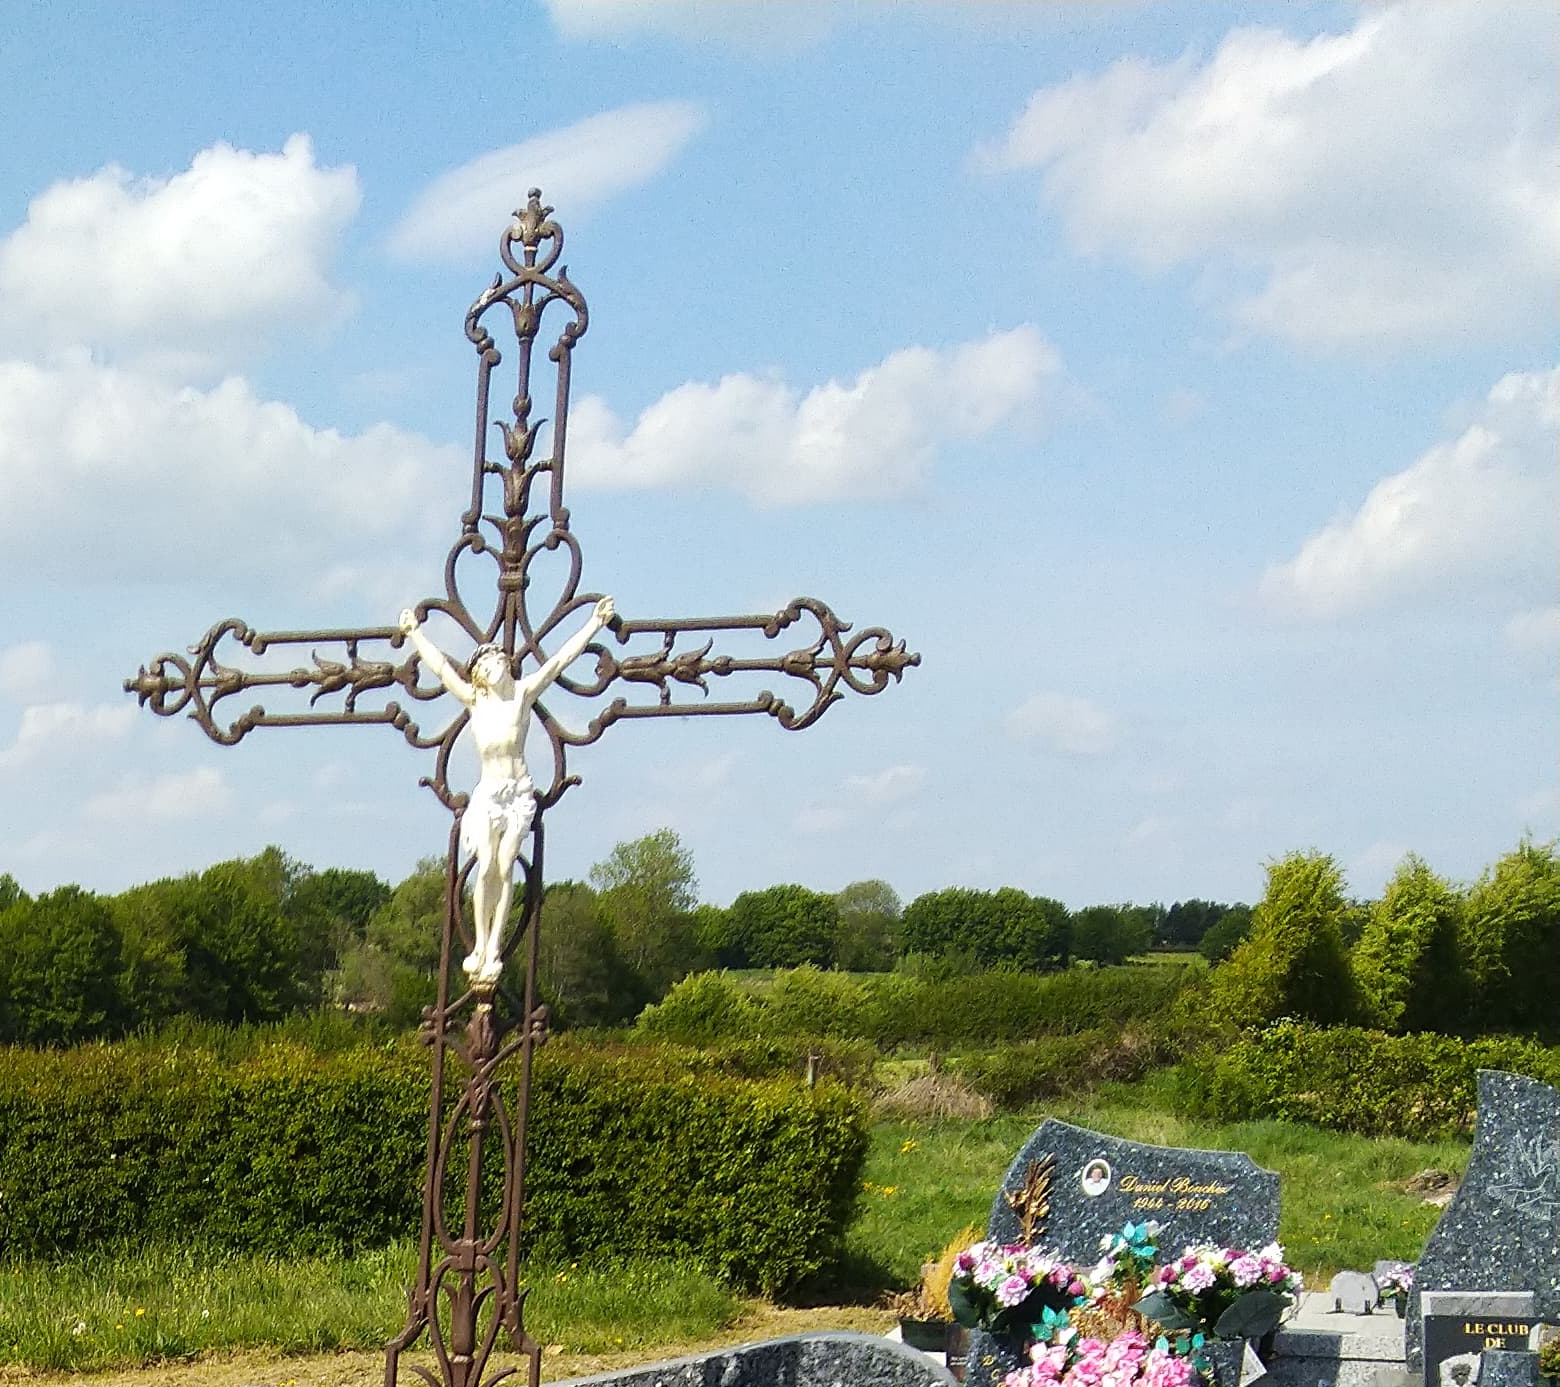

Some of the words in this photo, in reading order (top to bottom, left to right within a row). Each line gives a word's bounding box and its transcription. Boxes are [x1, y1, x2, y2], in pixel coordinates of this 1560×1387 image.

[1464, 1322, 1484, 1335] LE
[1486, 1323, 1529, 1336] CLUB
[1484, 1337, 1506, 1350] DE
